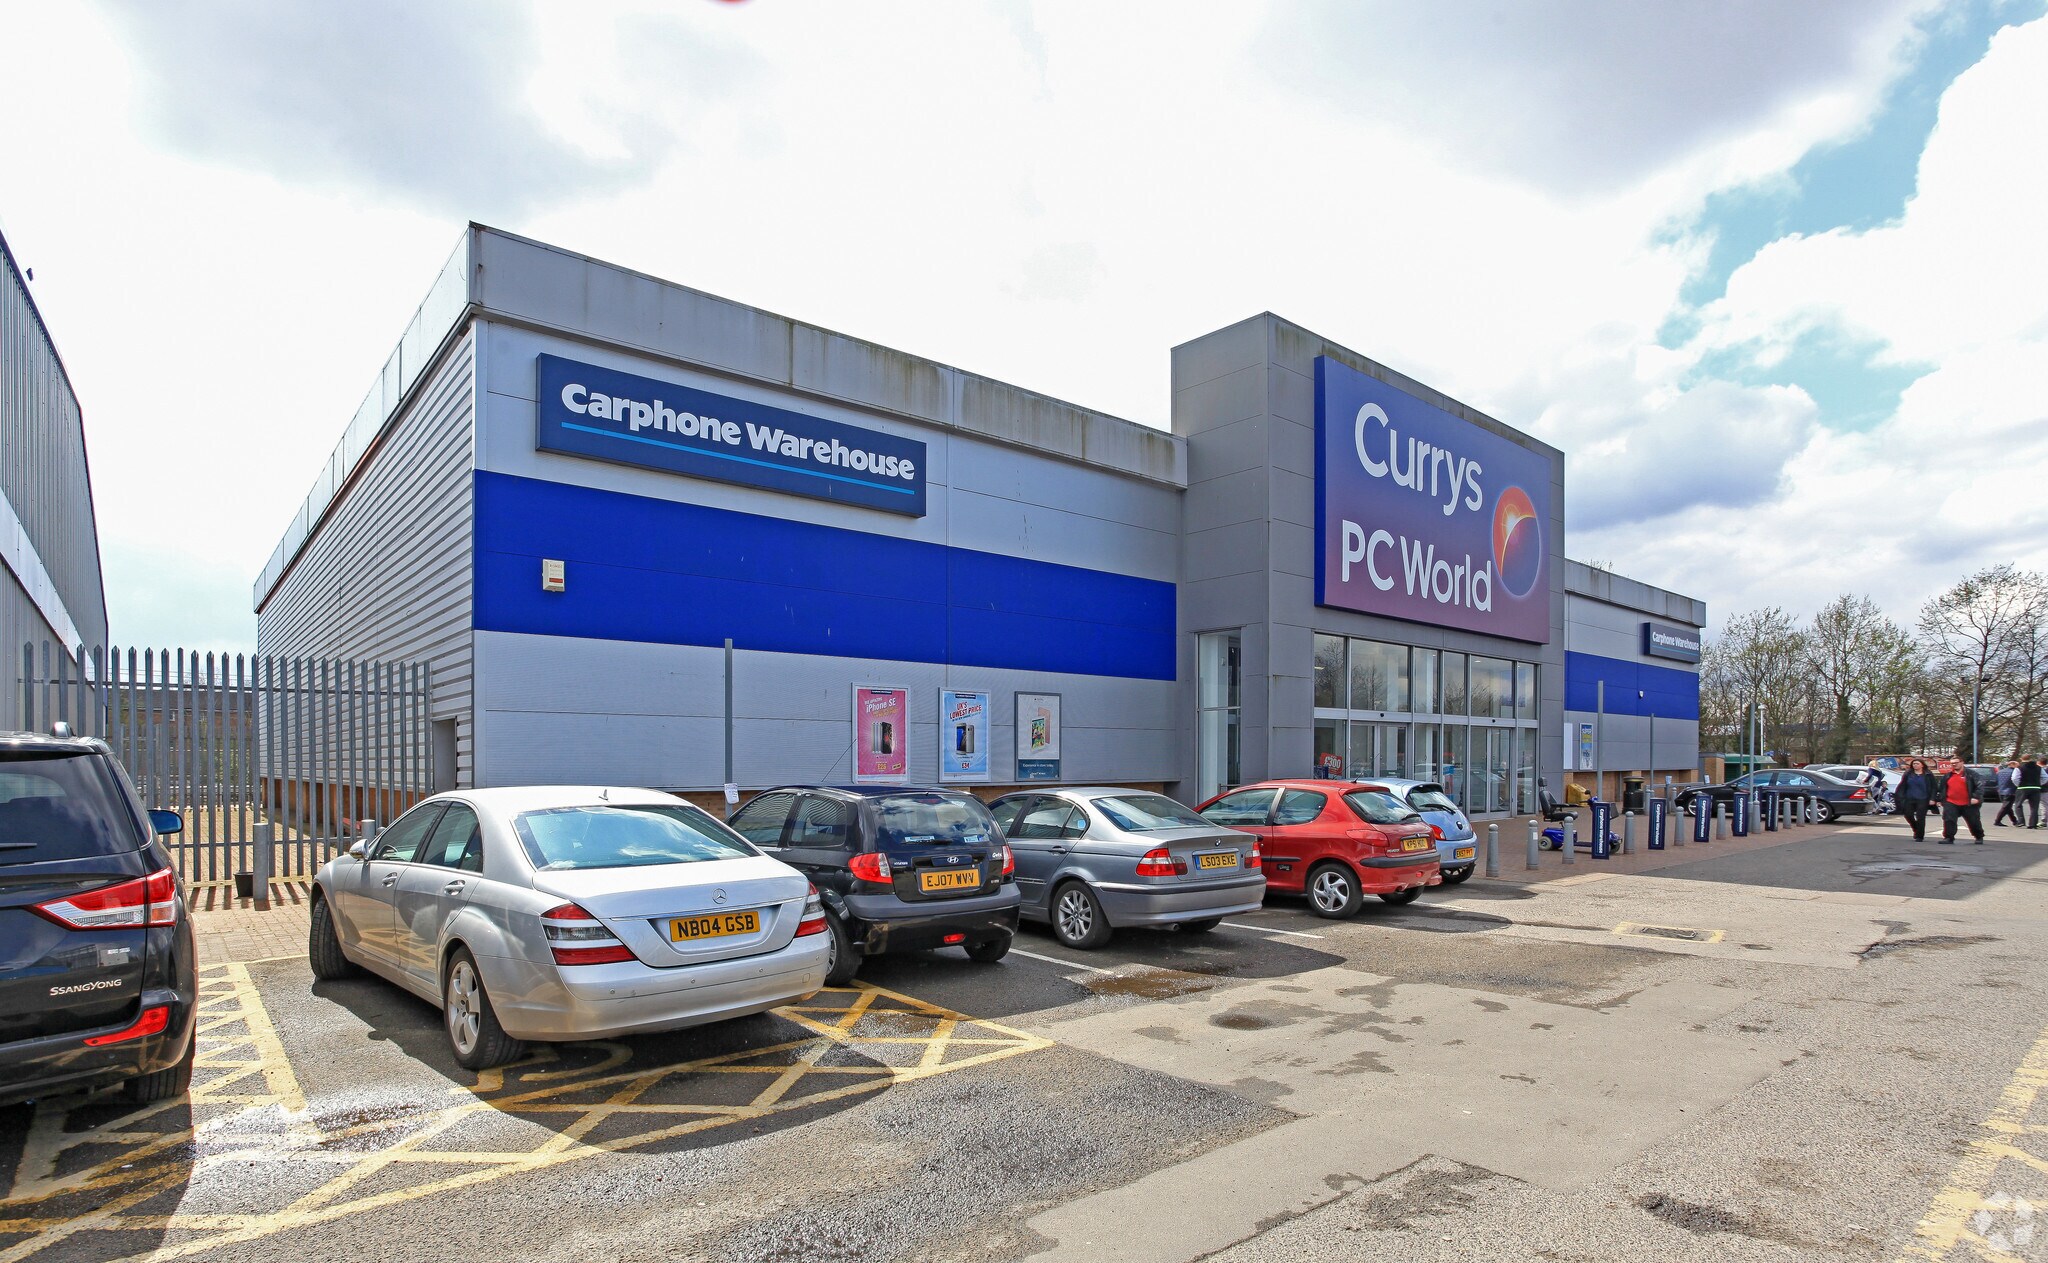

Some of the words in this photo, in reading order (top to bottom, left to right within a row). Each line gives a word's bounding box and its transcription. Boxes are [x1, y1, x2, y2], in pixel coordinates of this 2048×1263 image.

[561, 384, 741, 445] Carphone
[745, 421, 915, 480] Warehouse
[1354, 402, 1483, 516] Currys
[1341, 519, 1395, 591] PC
[1399, 535, 1492, 613] World
[1652, 631, 1675, 646] Carphone
[1674, 636, 1699, 651] Warehouse
[866, 700, 888, 713] iPhone
[888, 697, 897, 707] SE
[949, 709, 968, 720] LOWEST
[968, 704, 982, 714] PRICE
[1324, 756, 1341, 769] £300
[1200, 856, 1221, 867] LS03
[1222, 855, 1236, 865] EXE
[926, 874, 953, 887] EJ07
[955, 873, 974, 885] WVV
[677, 917, 721, 938] NB04
[725, 914, 754, 932] GSB
[50, 979, 122, 996] SSANGYONG
